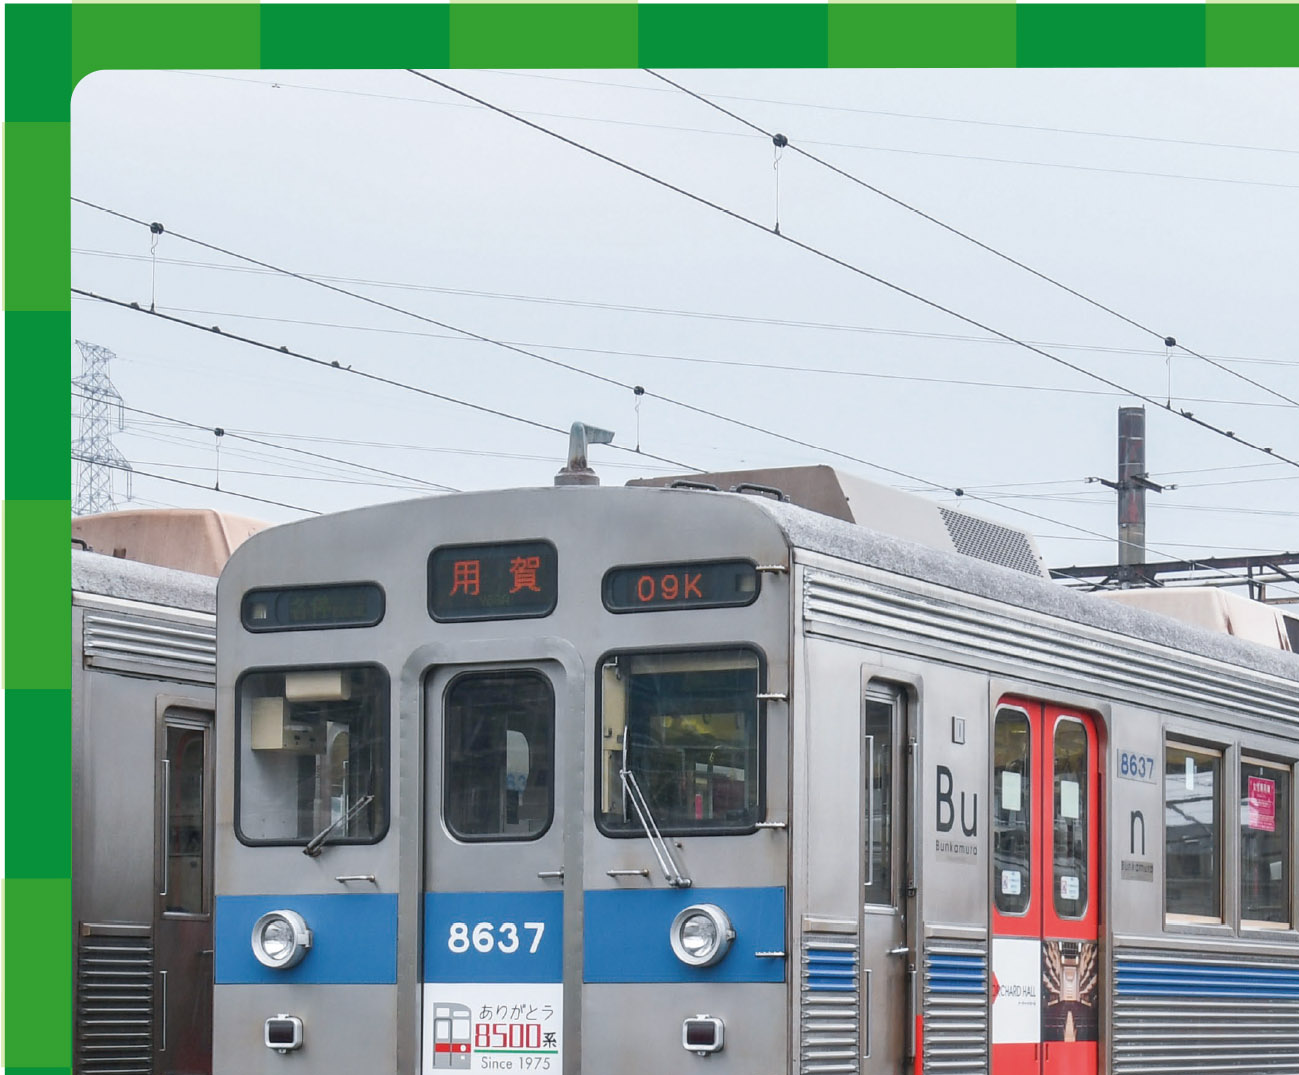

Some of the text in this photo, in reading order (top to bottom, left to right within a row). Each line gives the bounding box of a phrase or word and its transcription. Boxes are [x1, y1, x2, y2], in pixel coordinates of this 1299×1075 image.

[637, 574, 703, 602] 09K
[1120, 752, 1154, 780] 8637
[936, 765, 977, 837] Bu
[1130, 810, 1145, 855] n
[936, 839, 977, 856] Bunkamura
[447, 921, 545, 954] 8637
[479, 1003, 554, 1021] ありがとう
[474, 1023, 557, 1049] 8500系
[481, 1055, 551, 1071] Since 1975
